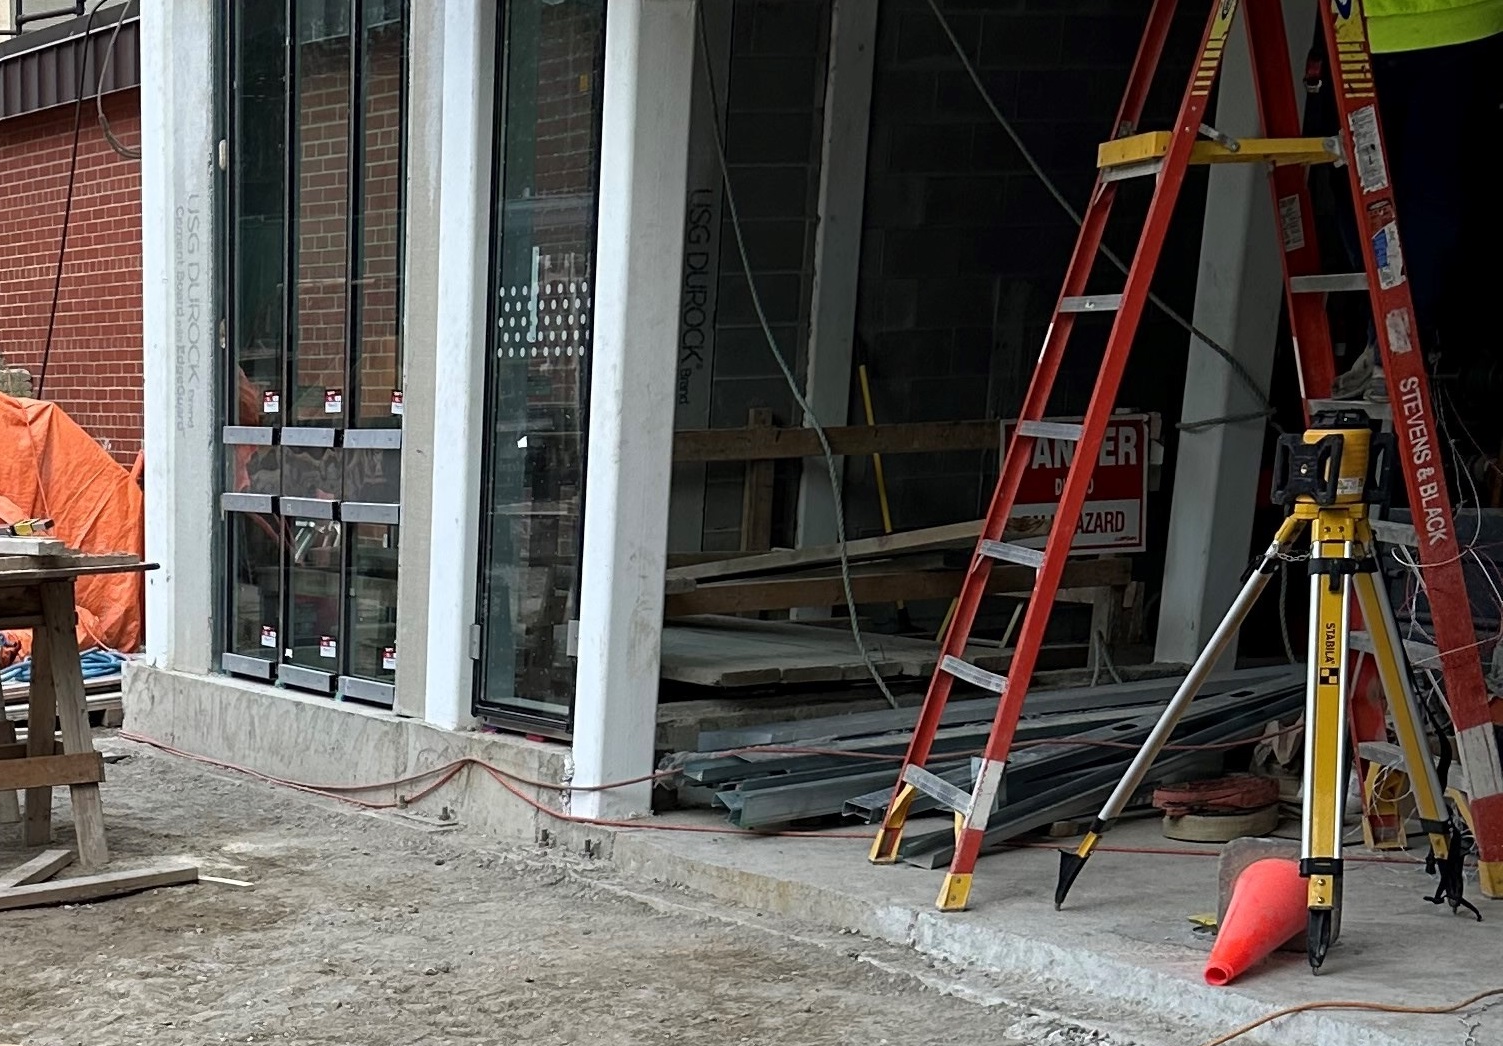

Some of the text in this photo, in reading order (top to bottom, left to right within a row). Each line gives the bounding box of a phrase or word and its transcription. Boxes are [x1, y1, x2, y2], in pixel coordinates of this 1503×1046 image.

[187, 194, 200, 254] USG
[187, 263, 200, 383] DUROCK
[679, 189, 713, 404] USG DUROCK Brand
[1031, 426, 1138, 469] ANER
[1399, 376, 1448, 546] STEVENS & BLACK
[1076, 510, 1126, 534] AZARD
[1325, 622, 1336, 664] STABILA
